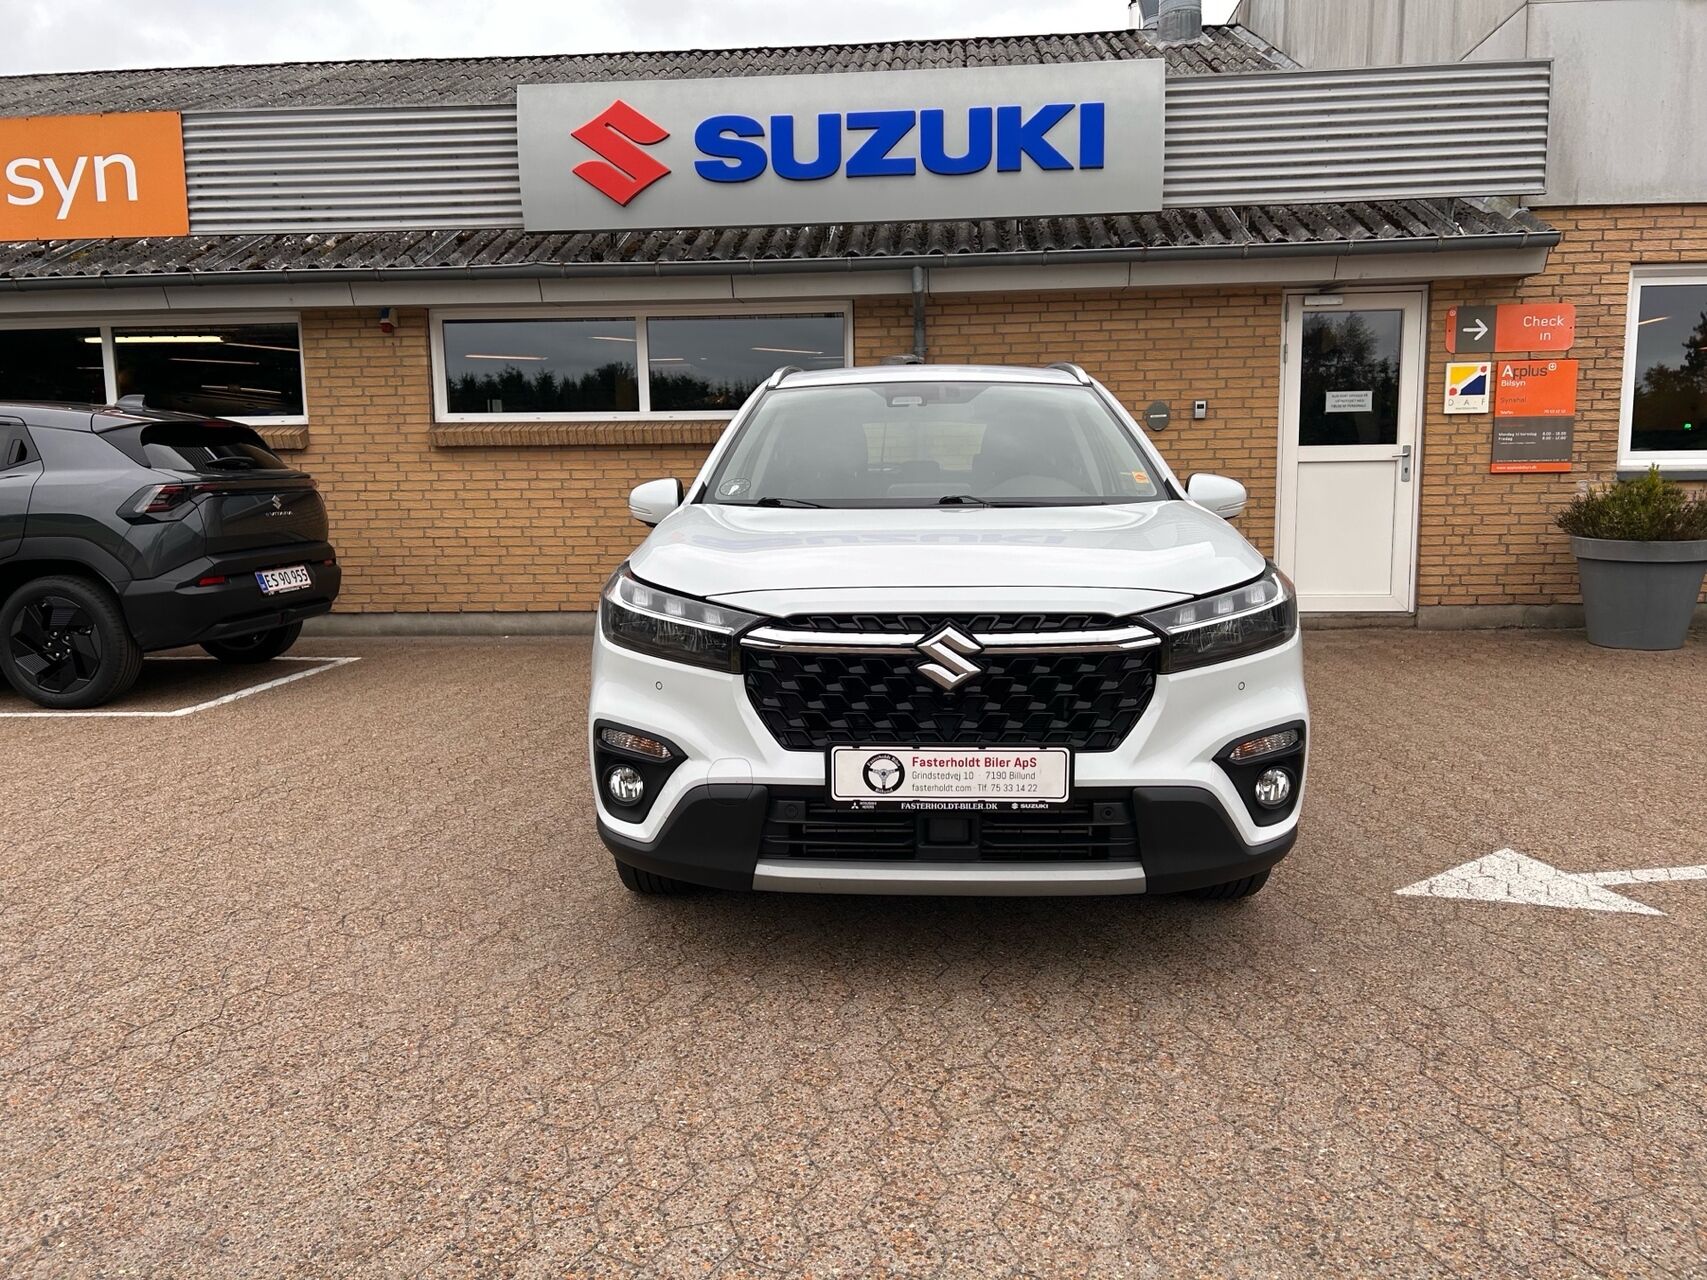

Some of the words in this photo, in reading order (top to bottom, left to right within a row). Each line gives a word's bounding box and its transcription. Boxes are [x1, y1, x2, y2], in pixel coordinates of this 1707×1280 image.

[694, 101, 1105, 183] SUZUKI
[5, 153, 139, 220] syn
[1523, 315, 1565, 328] Check
[1539, 332, 1552, 341] in
[1501, 379, 1526, 388] Bilsyn
[264, 573, 280, 589] ES
[278, 571, 293, 586] 90
[290, 568, 309, 584] 955
[912, 756, 980, 768] Fasterholdt
[984, 756, 1011, 768] Biler
[1013, 757, 1037, 770] ApS
[912, 770, 961, 781] Grindstedvej
[964, 771, 974, 779] 10
[985, 771, 1007, 780] 7190
[1009, 771, 1036, 780] Billund
[990, 783, 1001, 792] 75
[1003, 783, 1014, 792] 33
[1016, 783, 1026, 792] 14
[1027, 783, 1038, 792] 22
[901, 802, 998, 810] FASTERHOLDT-BILER.DK
